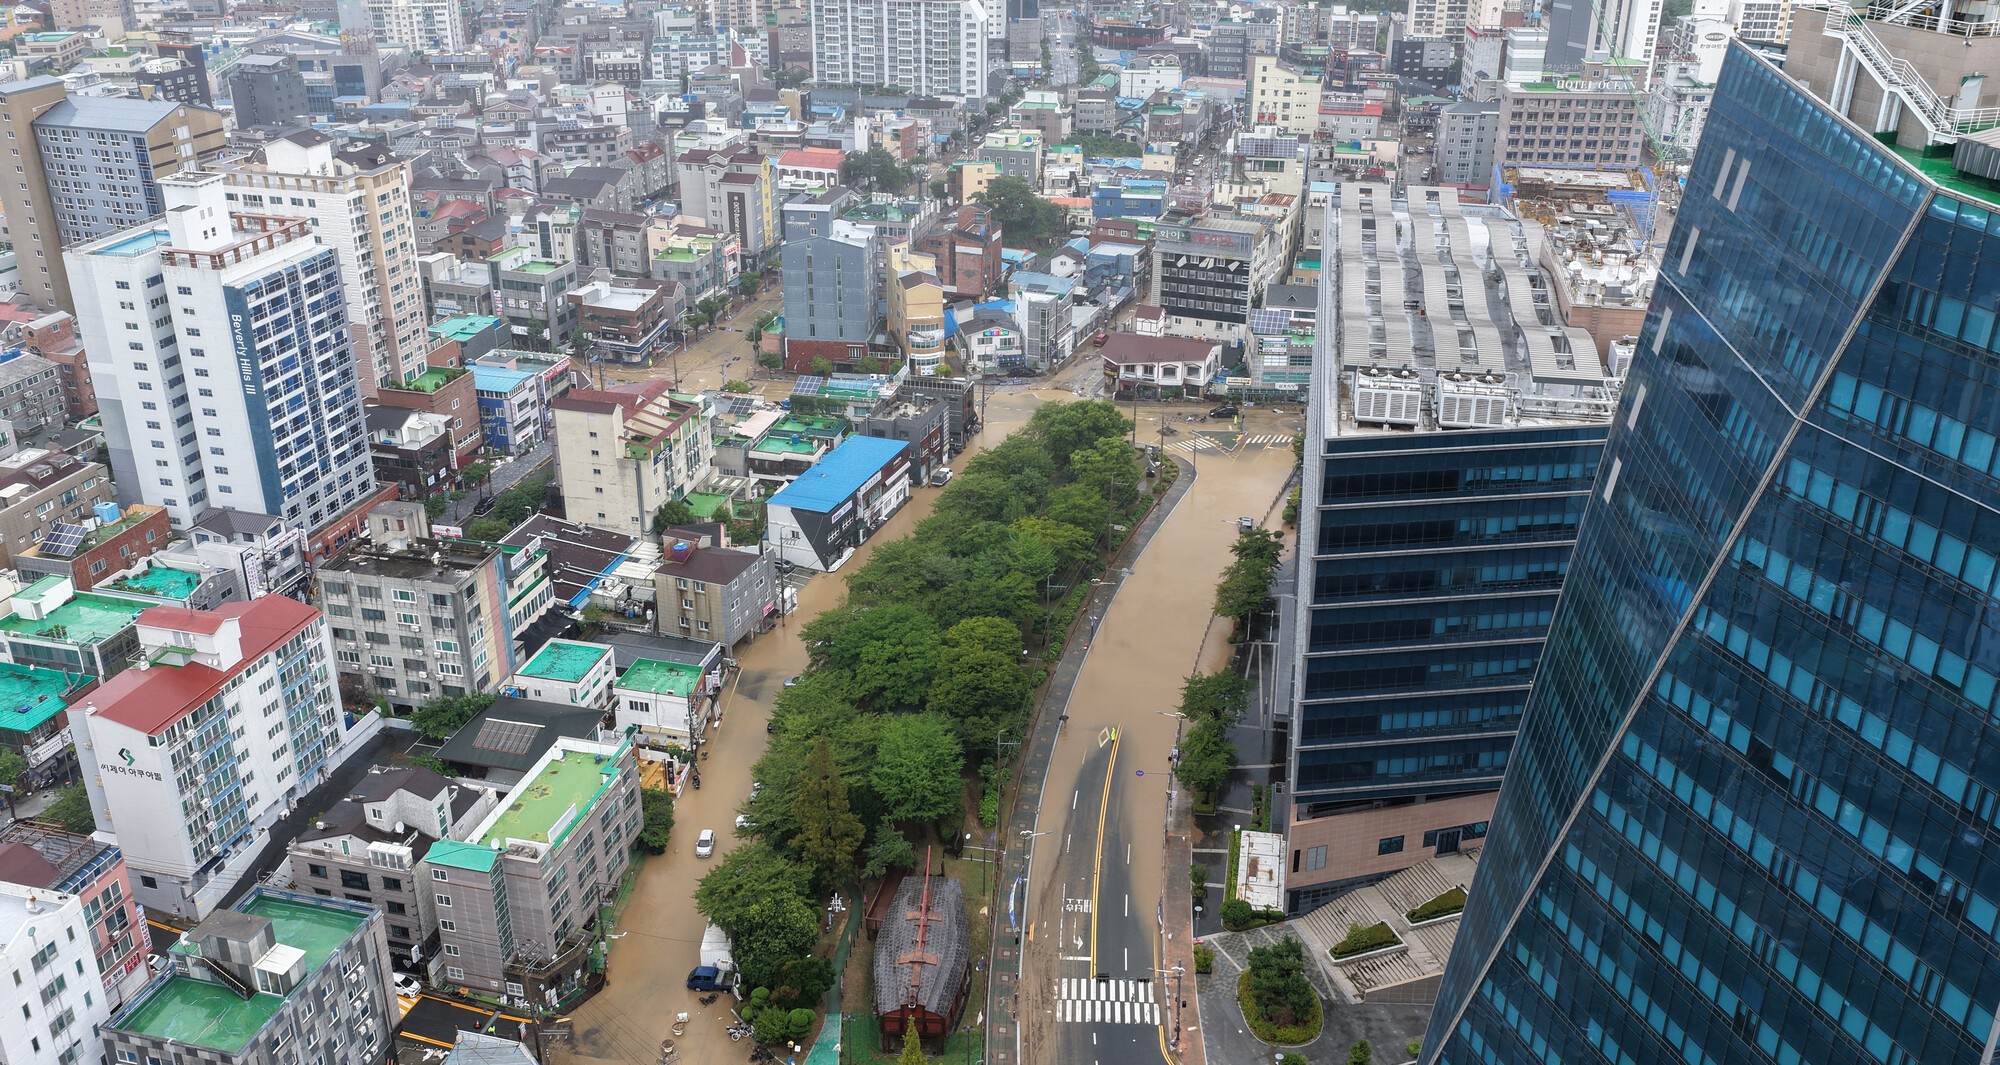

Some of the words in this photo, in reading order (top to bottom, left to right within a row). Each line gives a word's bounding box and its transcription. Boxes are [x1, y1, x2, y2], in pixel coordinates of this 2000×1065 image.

[1556, 80, 1592, 90] HOTEL
[1598, 80, 1637, 91] OCEAN
[232, 314, 247, 356] Beverly
[240, 358, 252, 381] Hills
[100, 763, 127, 776] 씨제이
[128, 768, 163, 782] 아쿠아빌
[1066, 898, 1092, 913] 비보호
